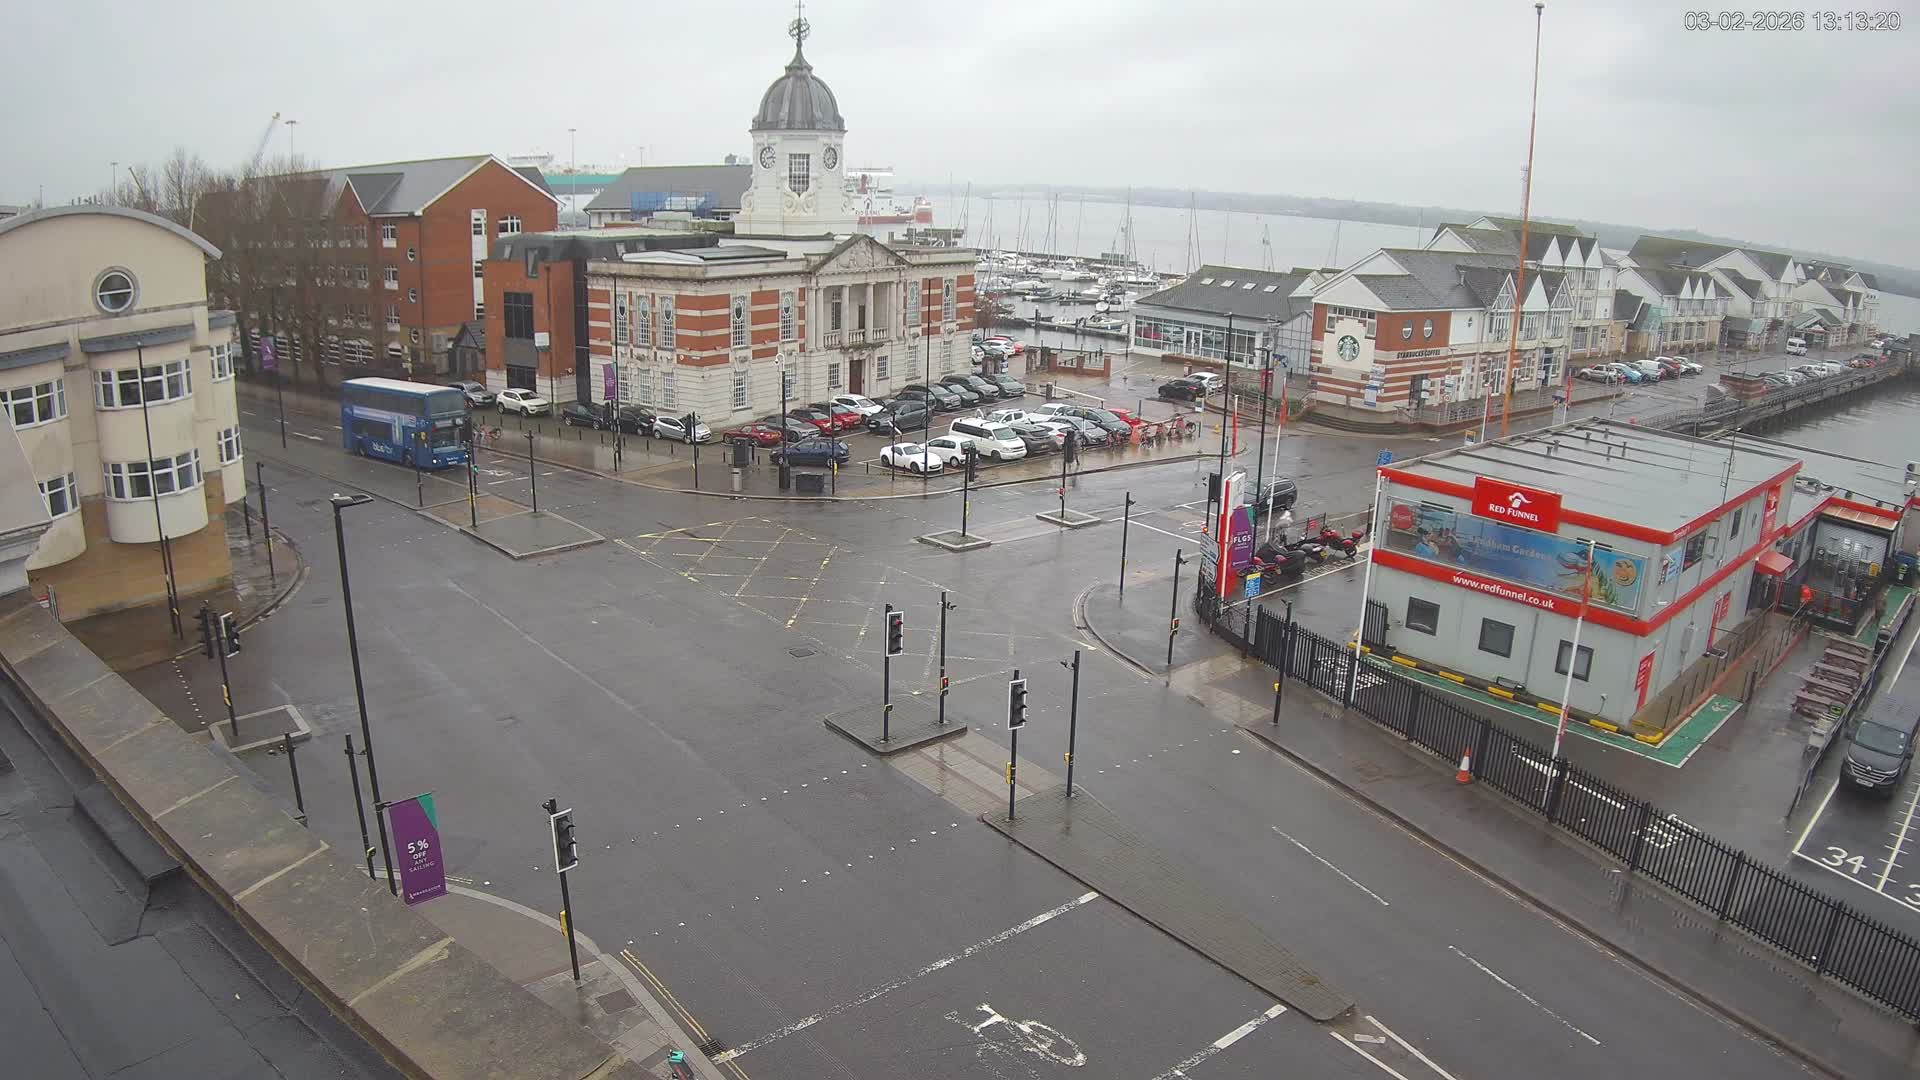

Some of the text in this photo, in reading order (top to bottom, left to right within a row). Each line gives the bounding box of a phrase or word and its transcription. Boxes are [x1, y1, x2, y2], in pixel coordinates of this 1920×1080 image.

[1397, 350, 1424, 359] STARBUCKS
[1489, 503, 1540, 522] RED FUNNEL
[1453, 576, 1555, 609] www.redfunnel.co.uk
[413, 850, 427, 860] OFF
[1821, 846, 1868, 874] 34
[409, 861, 435, 872] SAILING
